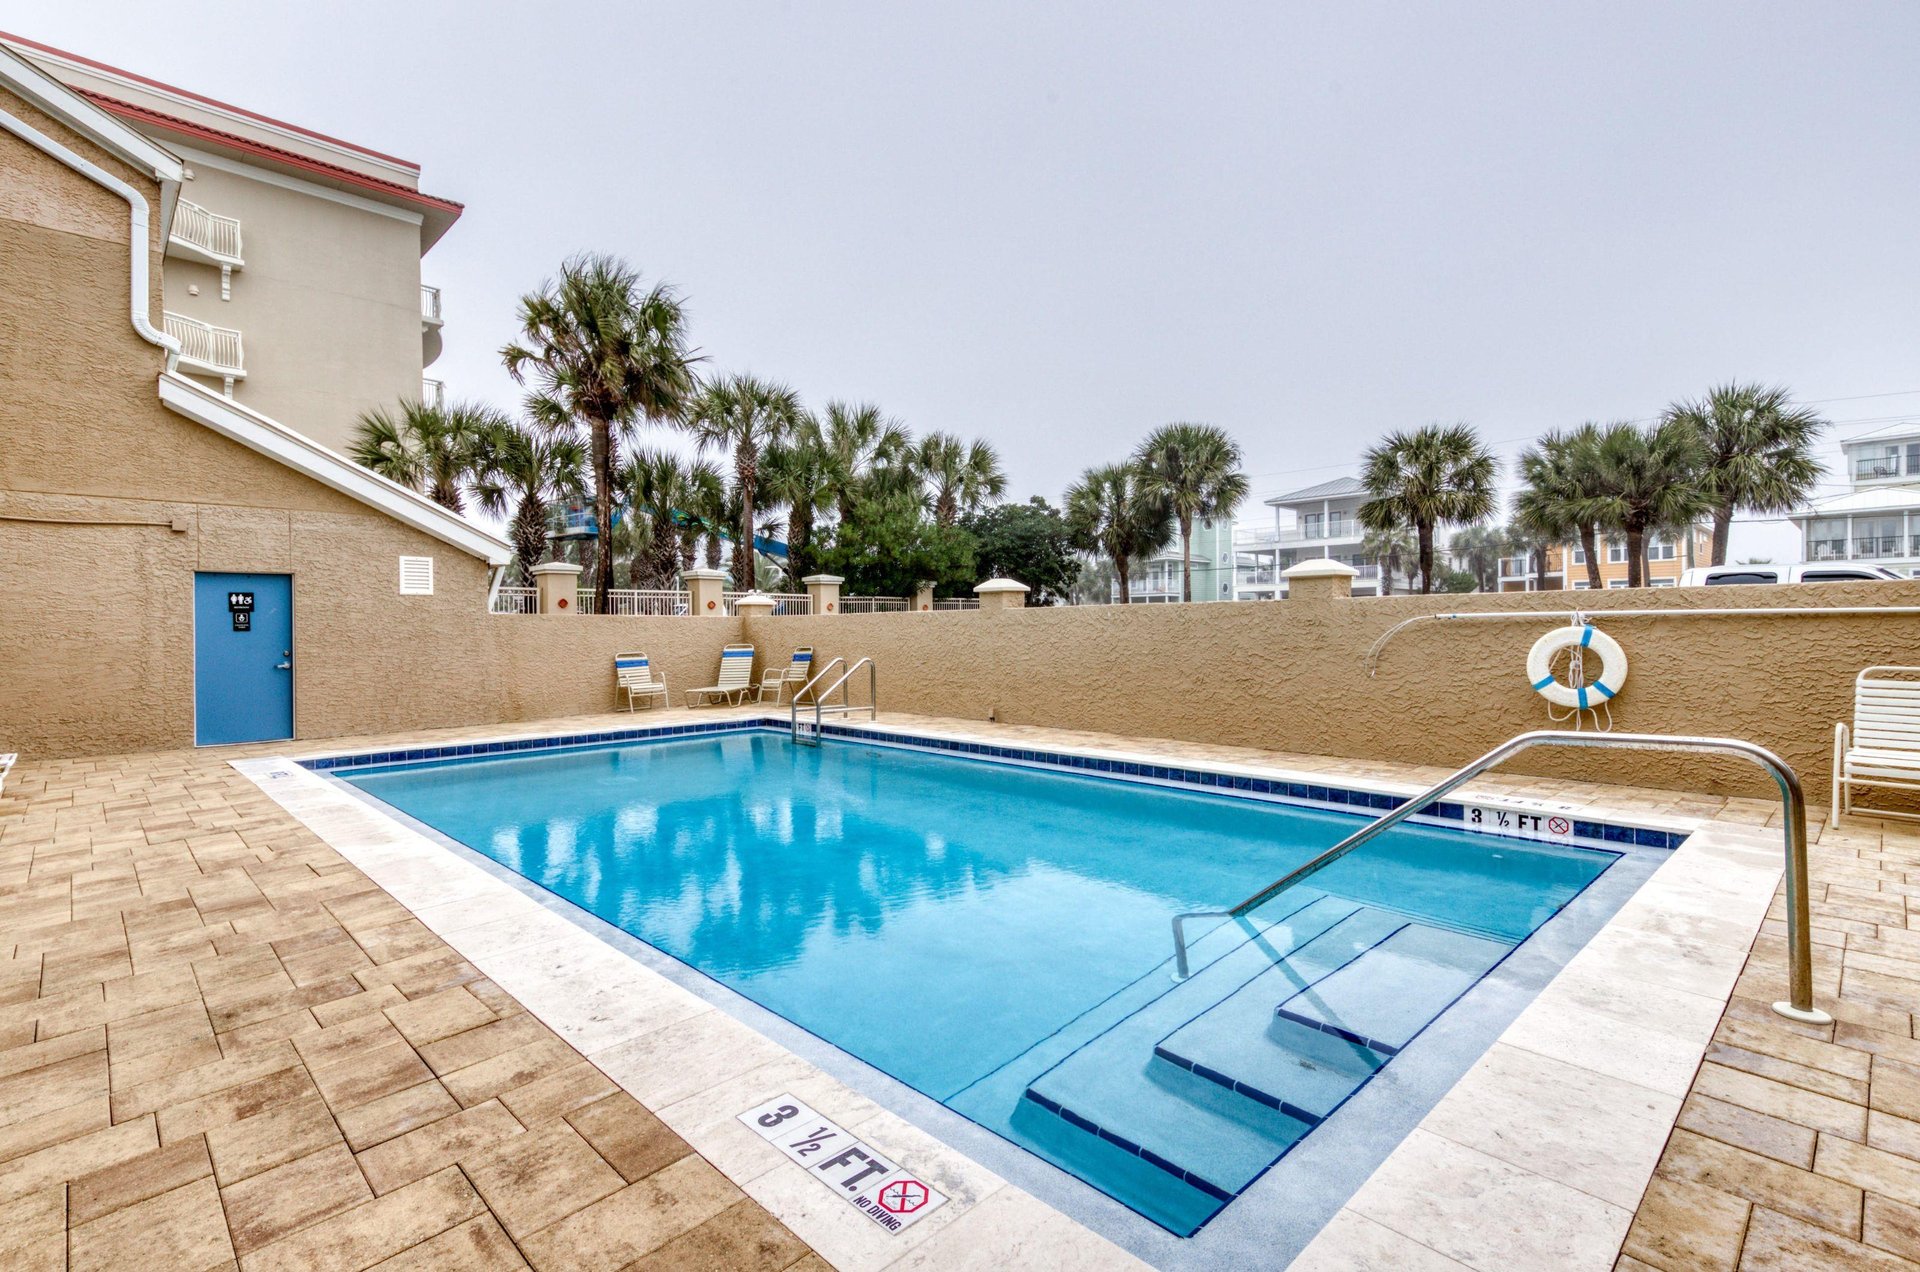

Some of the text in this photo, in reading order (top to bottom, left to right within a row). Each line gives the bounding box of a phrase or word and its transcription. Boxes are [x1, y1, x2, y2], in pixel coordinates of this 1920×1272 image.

[1471, 808, 1482, 823] 3
[1518, 814, 1542, 831] FT
[757, 1105, 800, 1128] 3
[818, 1147, 889, 1192] FT.
[853, 1195, 902, 1231] NO DIVING
